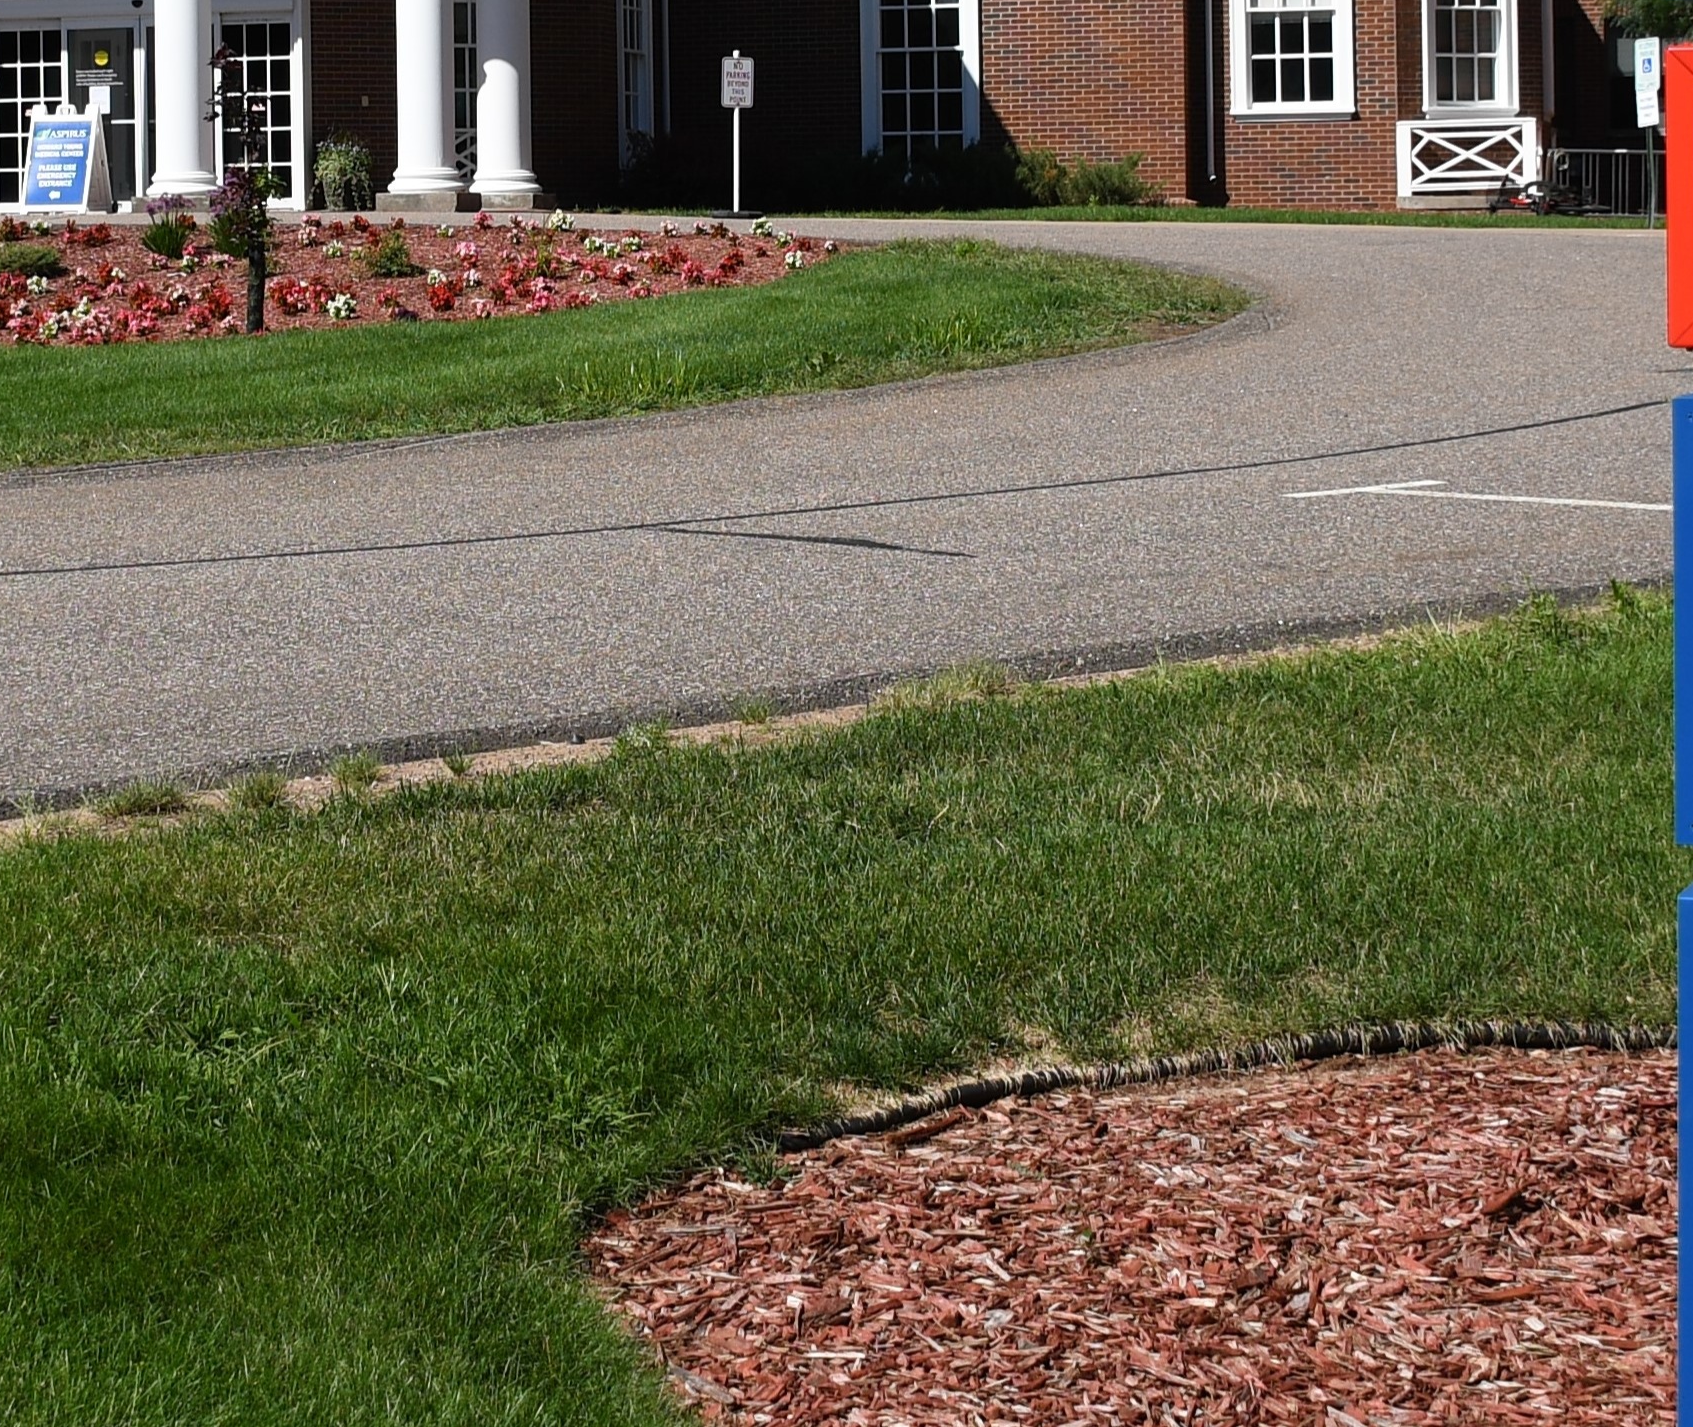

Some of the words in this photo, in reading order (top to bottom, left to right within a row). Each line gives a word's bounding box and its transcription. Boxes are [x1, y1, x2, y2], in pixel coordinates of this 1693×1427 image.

[733, 62, 743, 70] NO
[726, 71, 751, 80] PARKING
[50, 129, 87, 138] ASPIRUS
